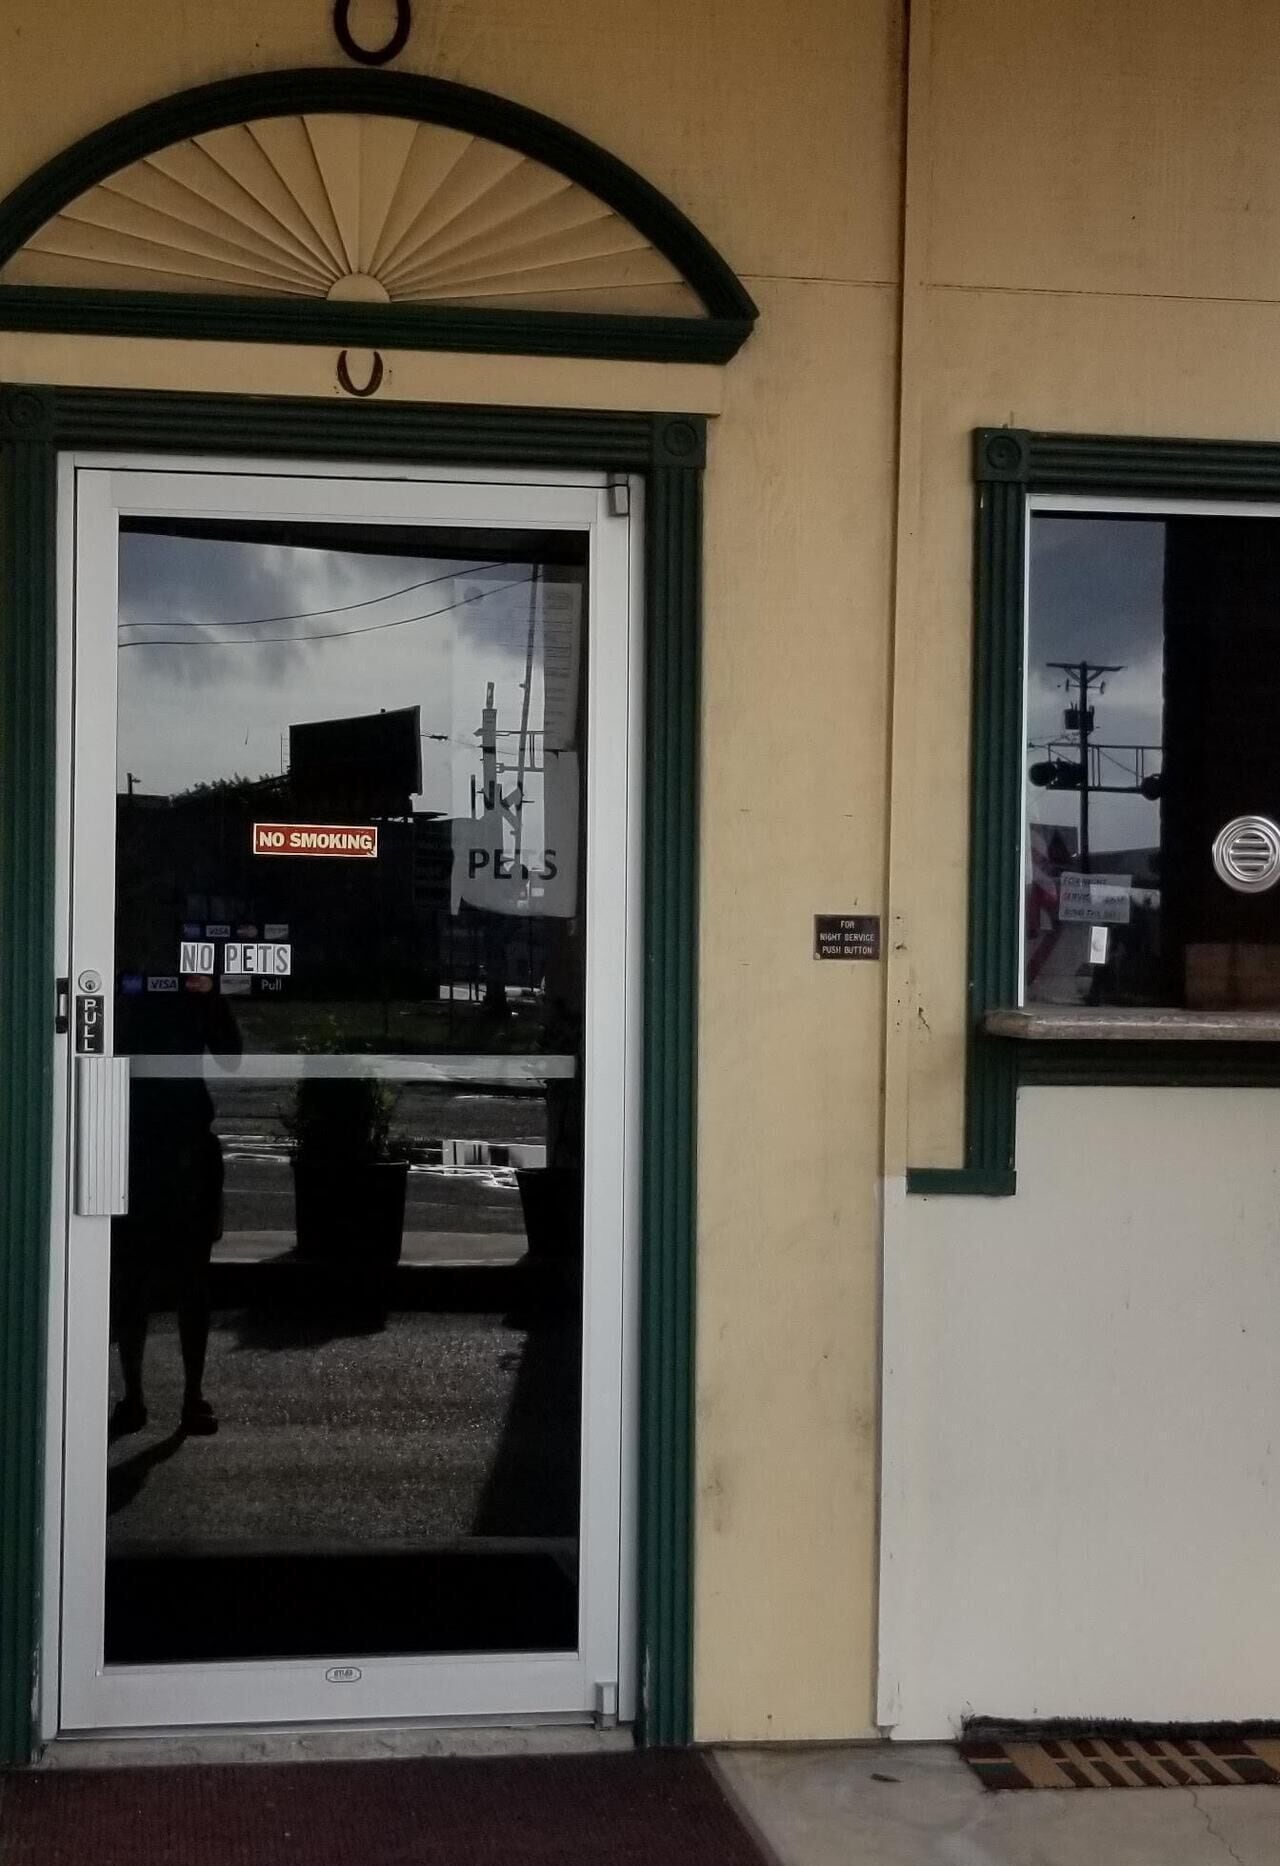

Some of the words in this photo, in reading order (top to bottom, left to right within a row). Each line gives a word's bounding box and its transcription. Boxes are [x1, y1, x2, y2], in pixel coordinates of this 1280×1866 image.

[259, 831, 285, 847] NO
[289, 832, 373, 850] SMOKING
[468, 848, 558, 881] PETS
[840, 920, 855, 929] FOR
[209, 927, 229, 935] VISA
[819, 933, 841, 942] NIGHT
[844, 933, 875, 942] SERVICE
[822, 946, 841, 954] PUSH
[844, 946, 873, 955] BUTTON
[182, 944, 213, 972] NO
[227, 945, 288, 973] PETS
[151, 979, 177, 989] VISA
[261, 980, 282, 991] Pull
[84, 998, 97, 1052] PULL
